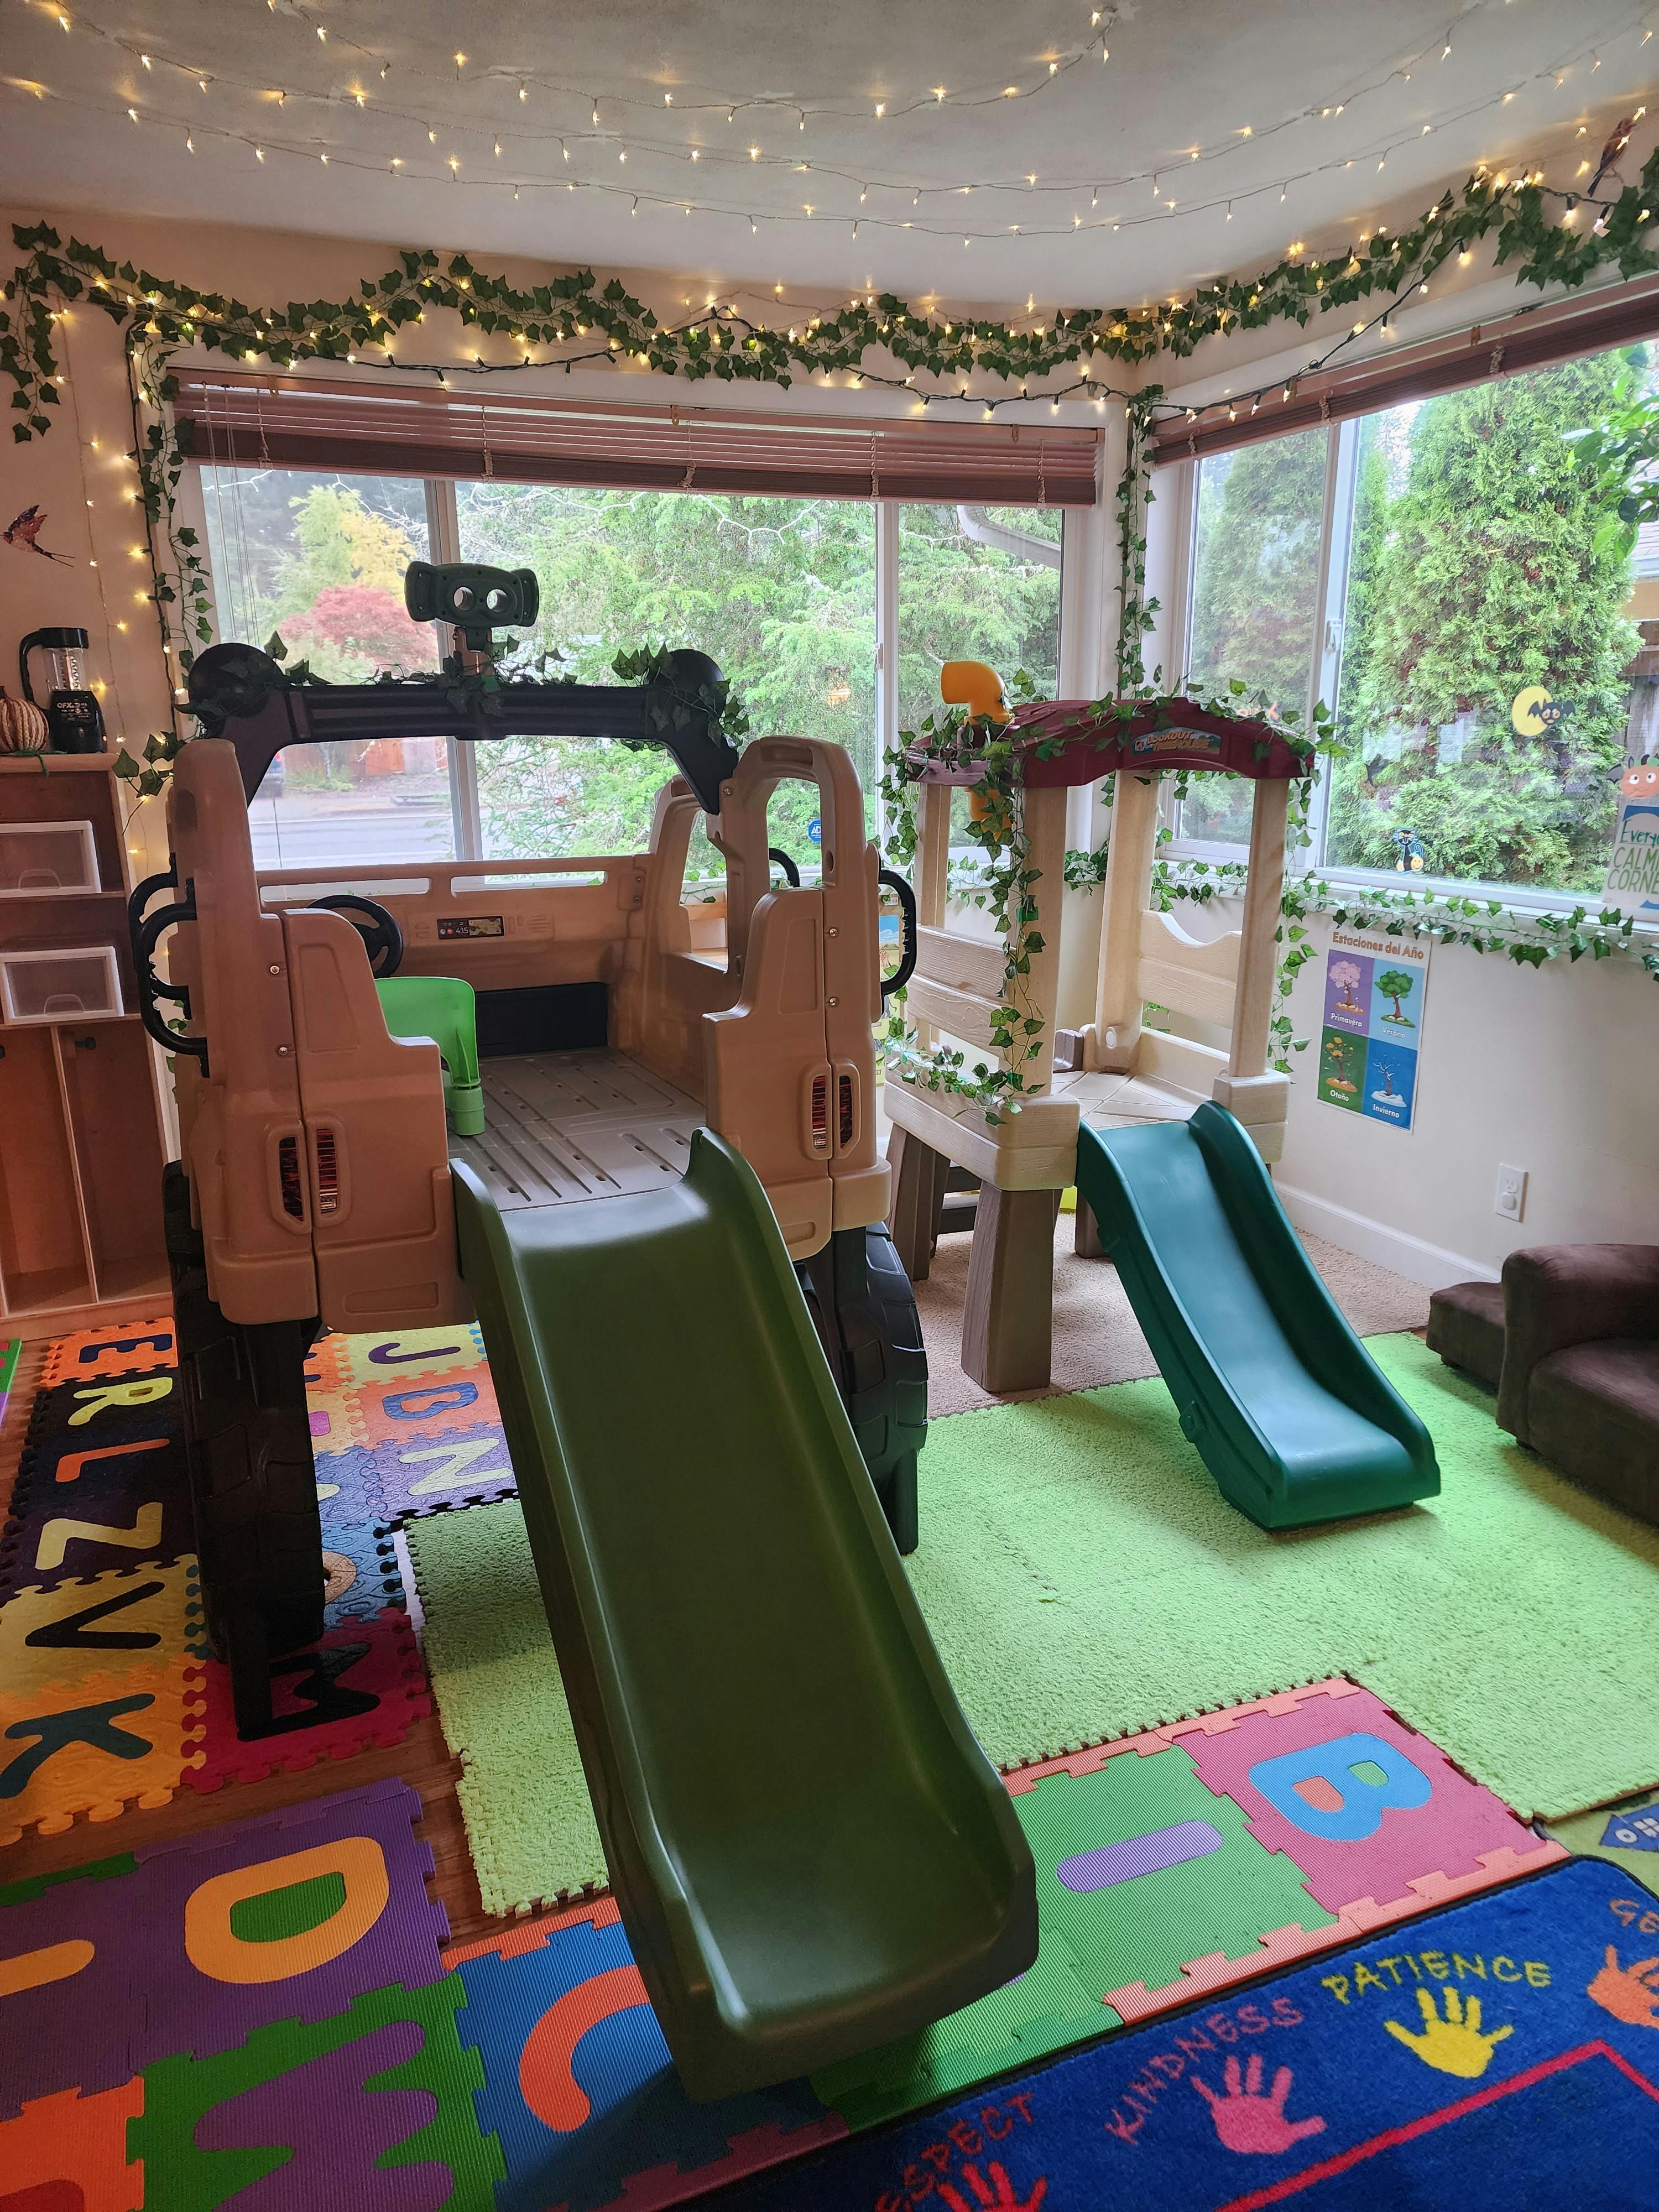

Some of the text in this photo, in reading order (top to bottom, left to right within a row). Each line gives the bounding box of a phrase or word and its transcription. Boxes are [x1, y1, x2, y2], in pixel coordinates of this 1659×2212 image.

[1147, 731, 1194, 744] LOOKOUT
[1333, 931, 1424, 959] Estaciones del Año
[1331, 1013, 1363, 1027] Primavera
[1383, 1026, 1406, 1039] Verano
[1330, 1089, 1349, 1102] Otoño
[1373, 1103, 1400, 1118] Invierno
[79, 1333, 173, 1363] E
[368, 1342, 461, 1364] J
[67, 1377, 173, 1426] R
[1248, 1732, 1433, 1842] B
[185, 1836, 389, 1984] D
[1321, 1951, 1552, 2005] PATIENCE
[1105, 1997, 1305, 2146] KINDNESS
